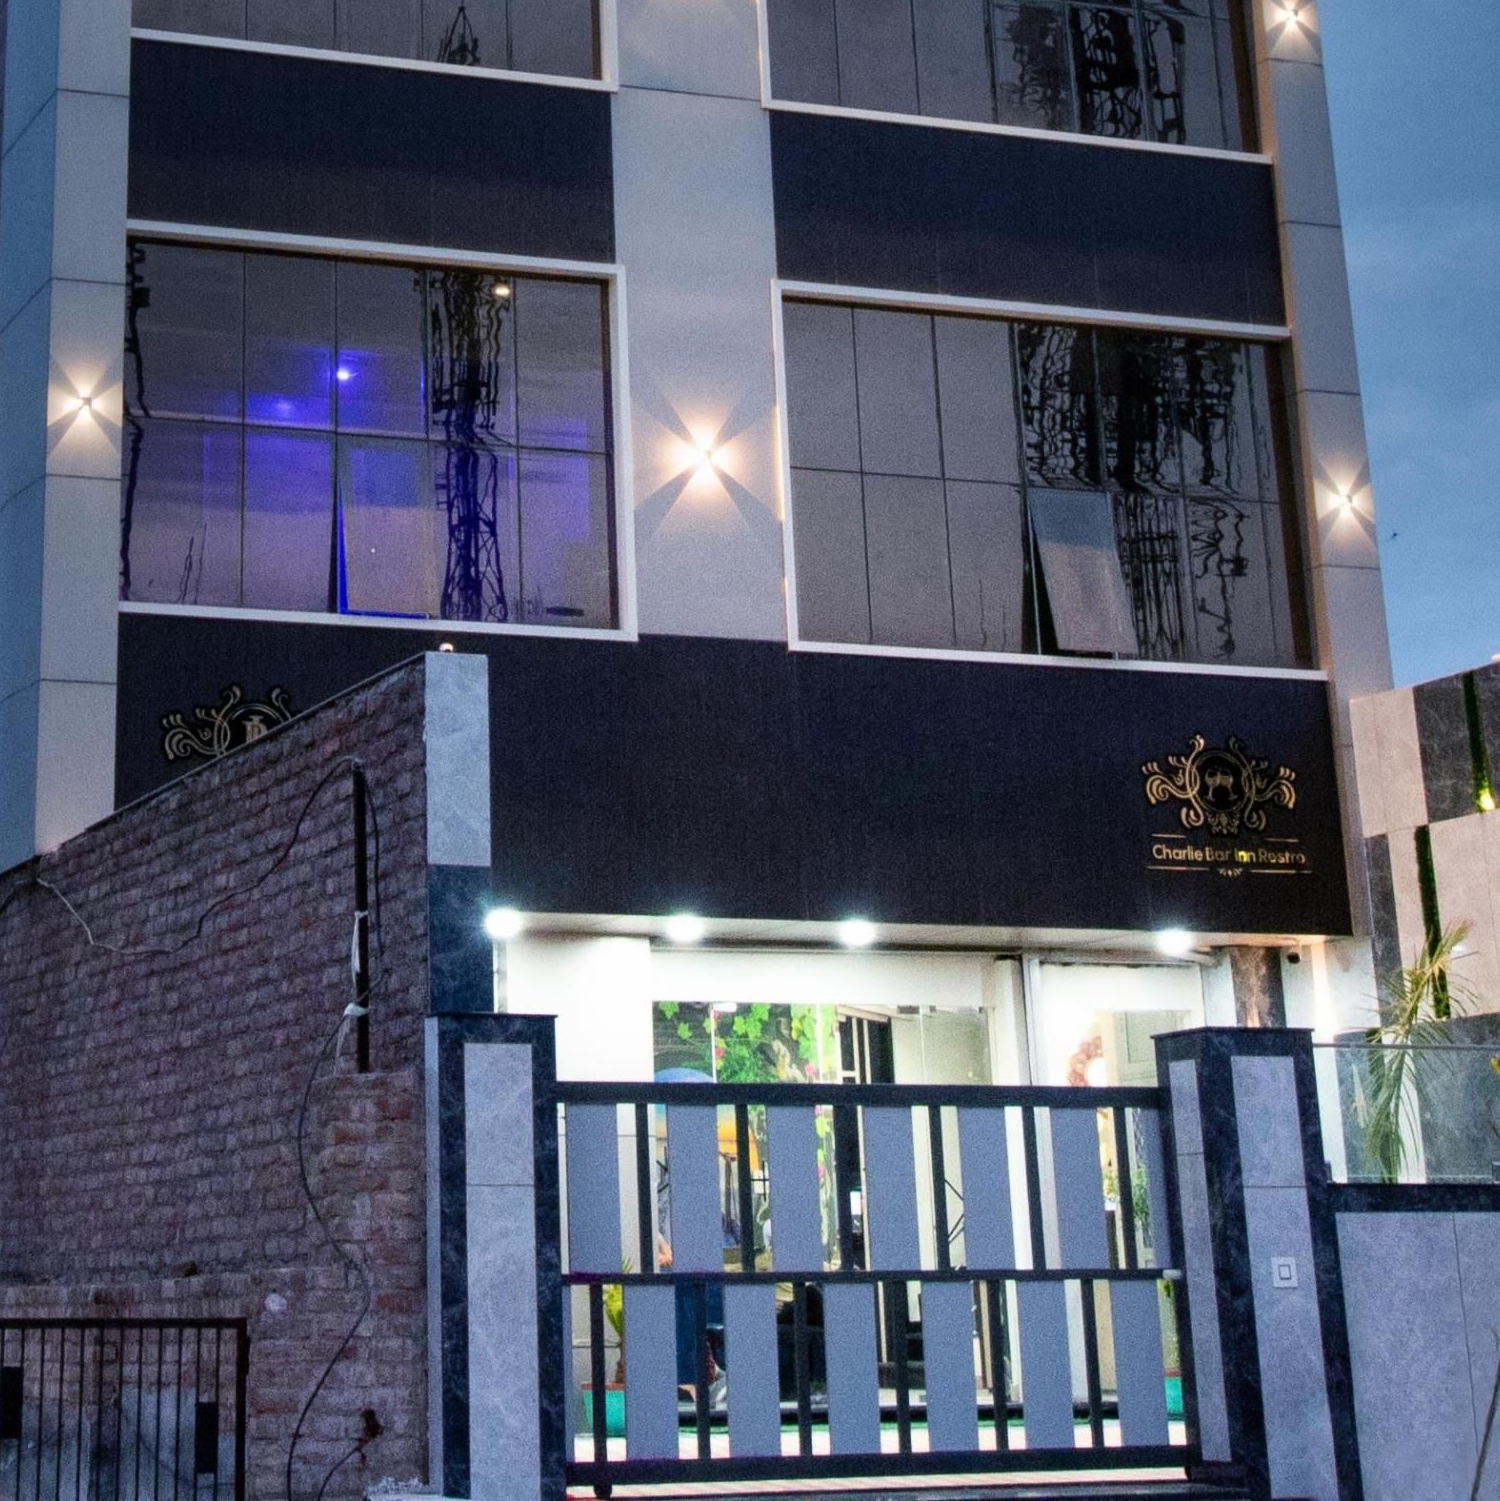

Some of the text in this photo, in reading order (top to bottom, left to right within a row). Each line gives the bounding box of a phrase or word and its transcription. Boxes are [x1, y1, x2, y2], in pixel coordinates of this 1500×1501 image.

[1152, 844, 1204, 861] Charlie
[1205, 845, 1231, 862] Bar
[1235, 847, 1257, 863] Inn
